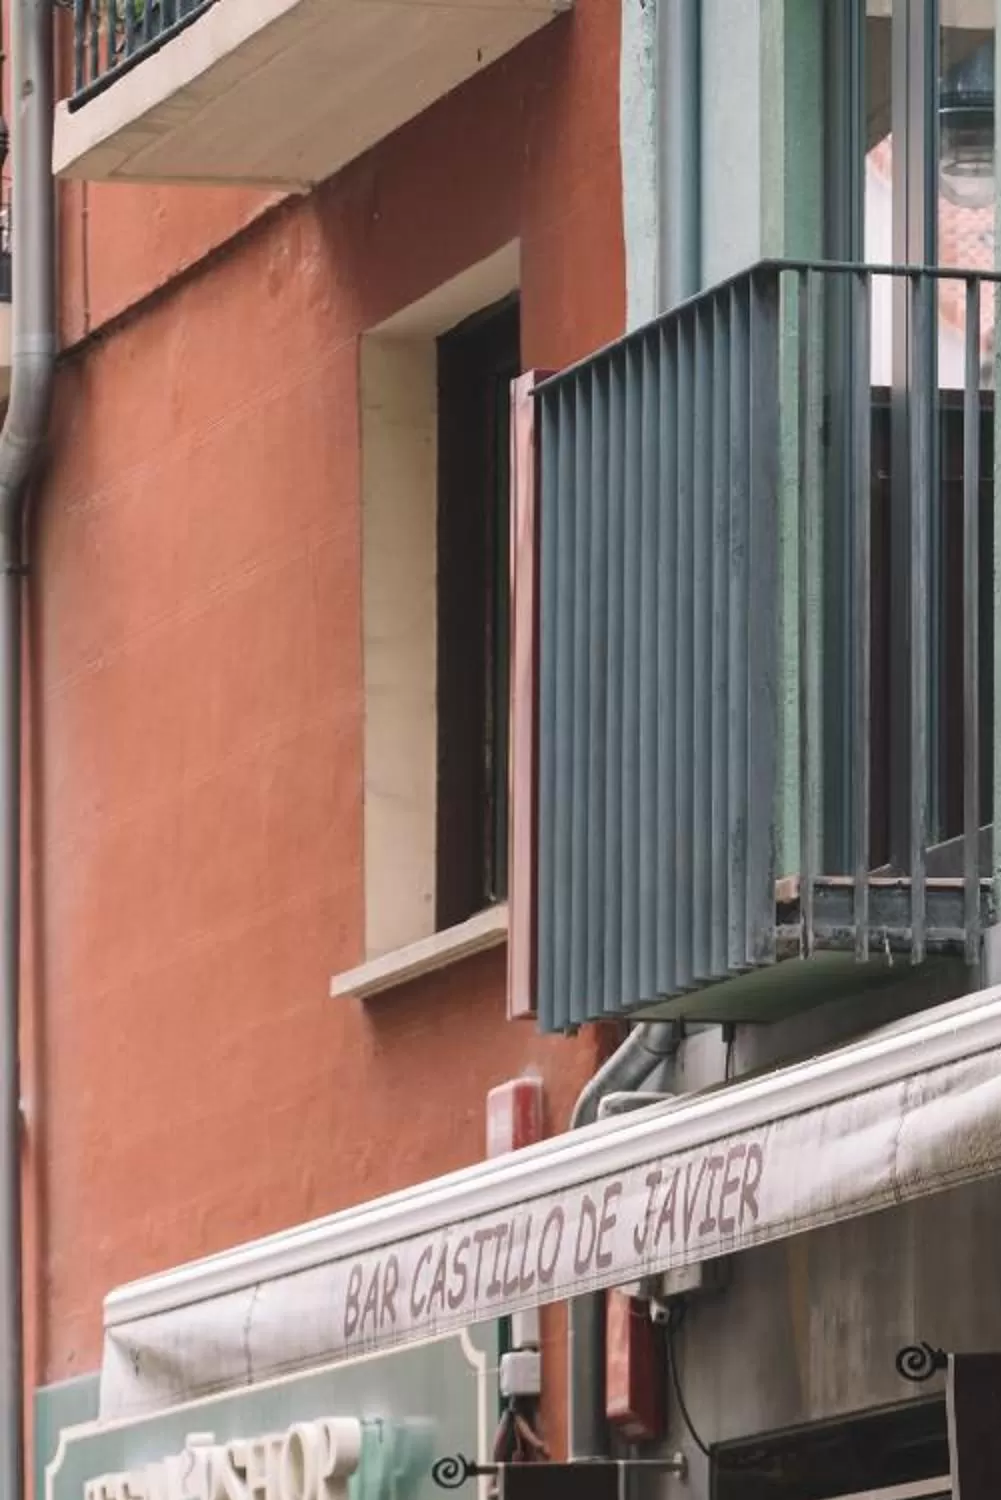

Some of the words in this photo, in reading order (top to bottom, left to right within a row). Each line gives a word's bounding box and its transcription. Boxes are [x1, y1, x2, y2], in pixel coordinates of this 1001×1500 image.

[343, 1252, 400, 1339] BAR
[410, 1205, 565, 1318] CASTILLO
[573, 1181, 623, 1277] DE
[633, 1142, 765, 1256] JAVIER
